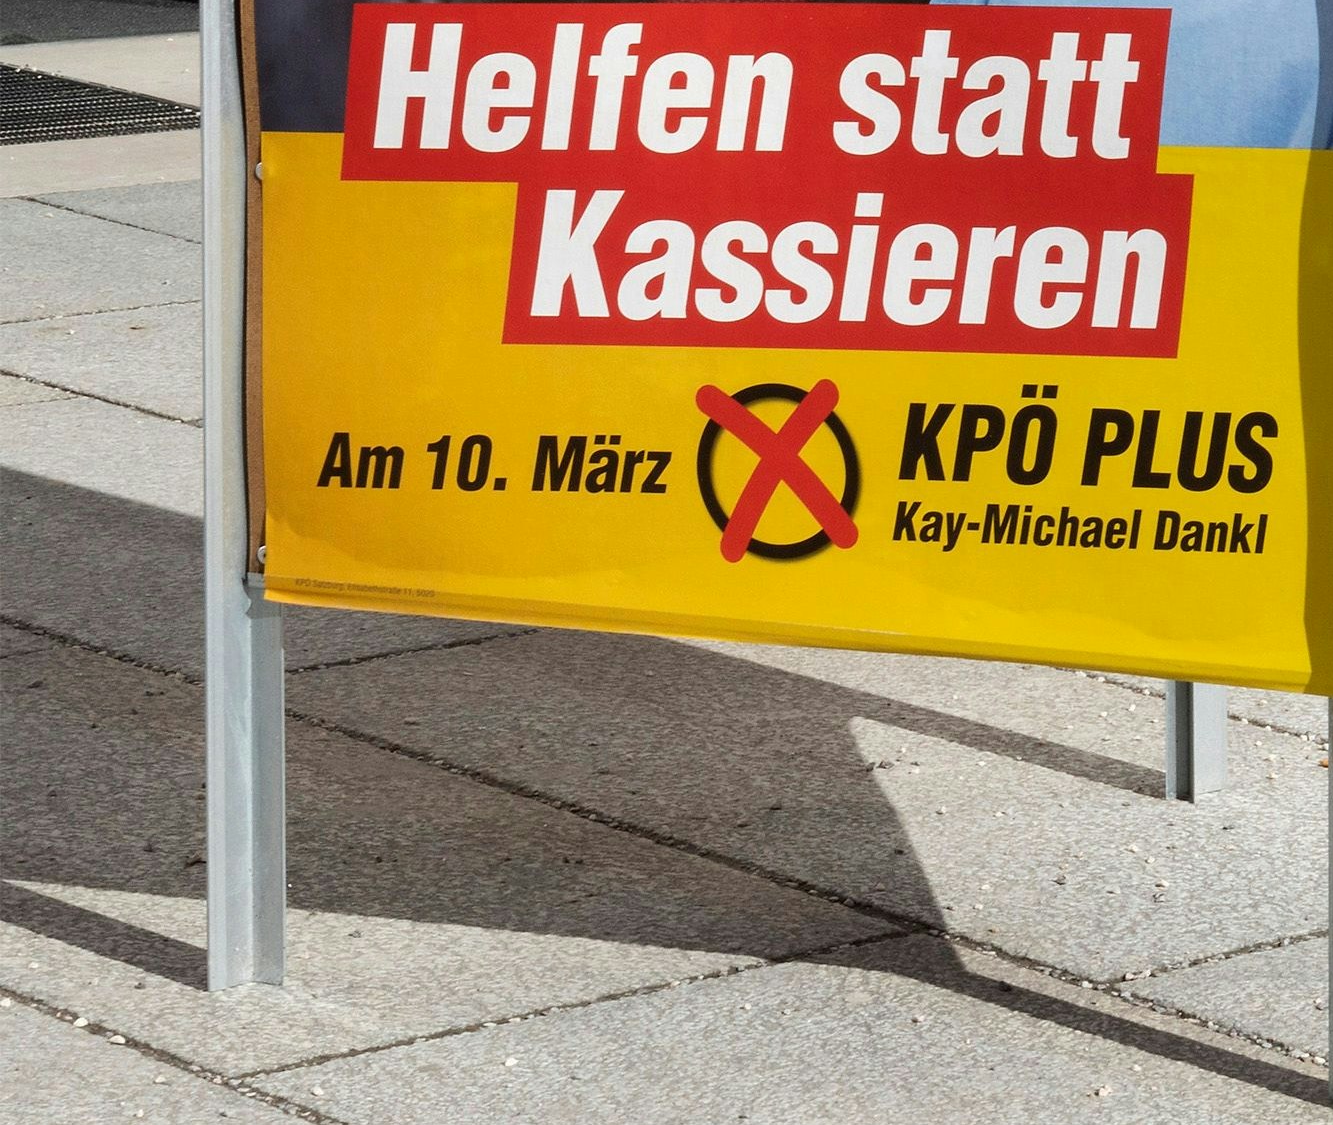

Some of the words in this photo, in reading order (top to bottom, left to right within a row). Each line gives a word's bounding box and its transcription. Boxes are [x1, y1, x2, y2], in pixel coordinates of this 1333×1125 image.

[373, 23, 794, 155] Helfen
[833, 30, 1140, 159] statt
[530, 189, 1167, 330] Kassieren
[316, 432, 405, 489] Am
[426, 434, 508, 492] 10.
[531, 434, 673, 494] März
[898, 384, 1060, 486] KPÖ
[1080, 408, 1280, 494] PLUS
[892, 501, 1142, 553] Kay-Michael
[1153, 510, 1269, 554] Dankl
